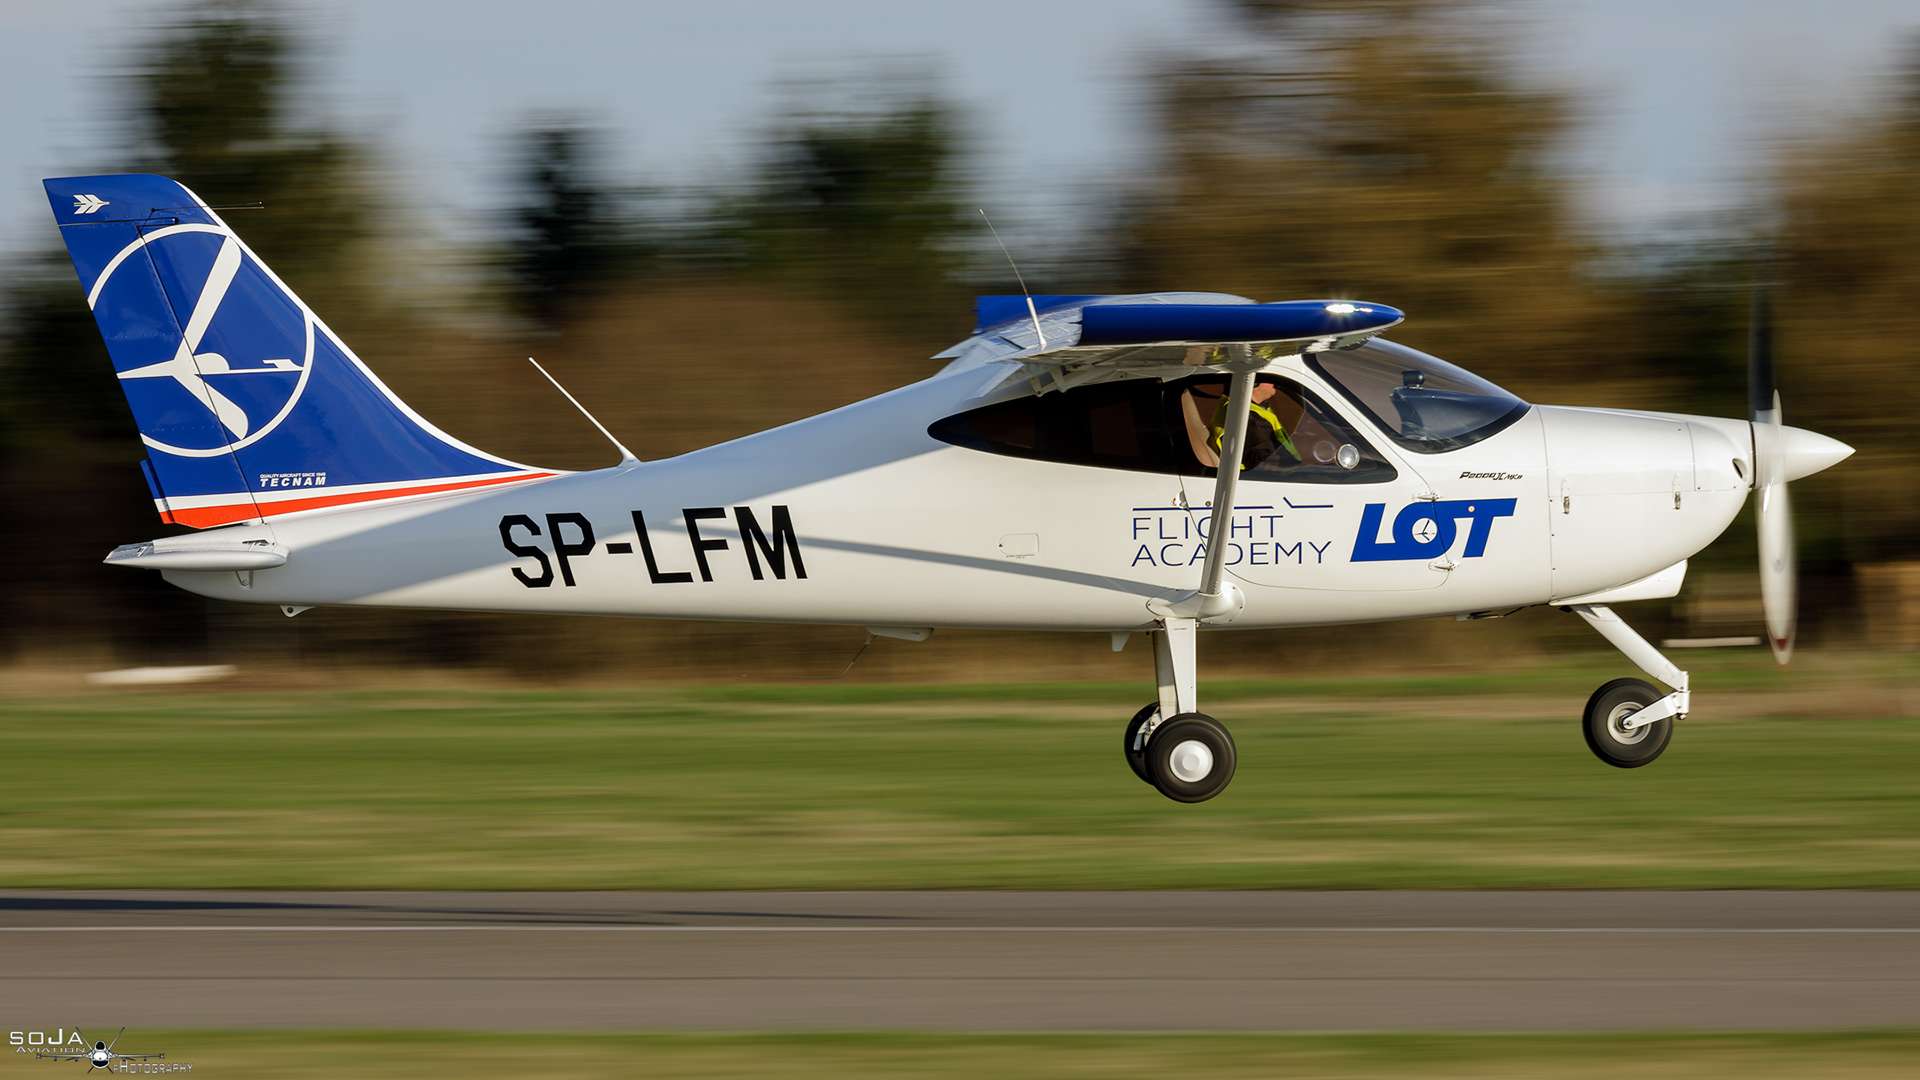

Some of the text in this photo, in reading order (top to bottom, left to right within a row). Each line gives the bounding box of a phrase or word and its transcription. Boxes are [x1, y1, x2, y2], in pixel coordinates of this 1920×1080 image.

[260, 477, 326, 487] TECNAM
[498, 505, 808, 588] SP-LFM
[1350, 497, 1518, 562] LOT
[1131, 541, 1332, 567] ACADEMY
